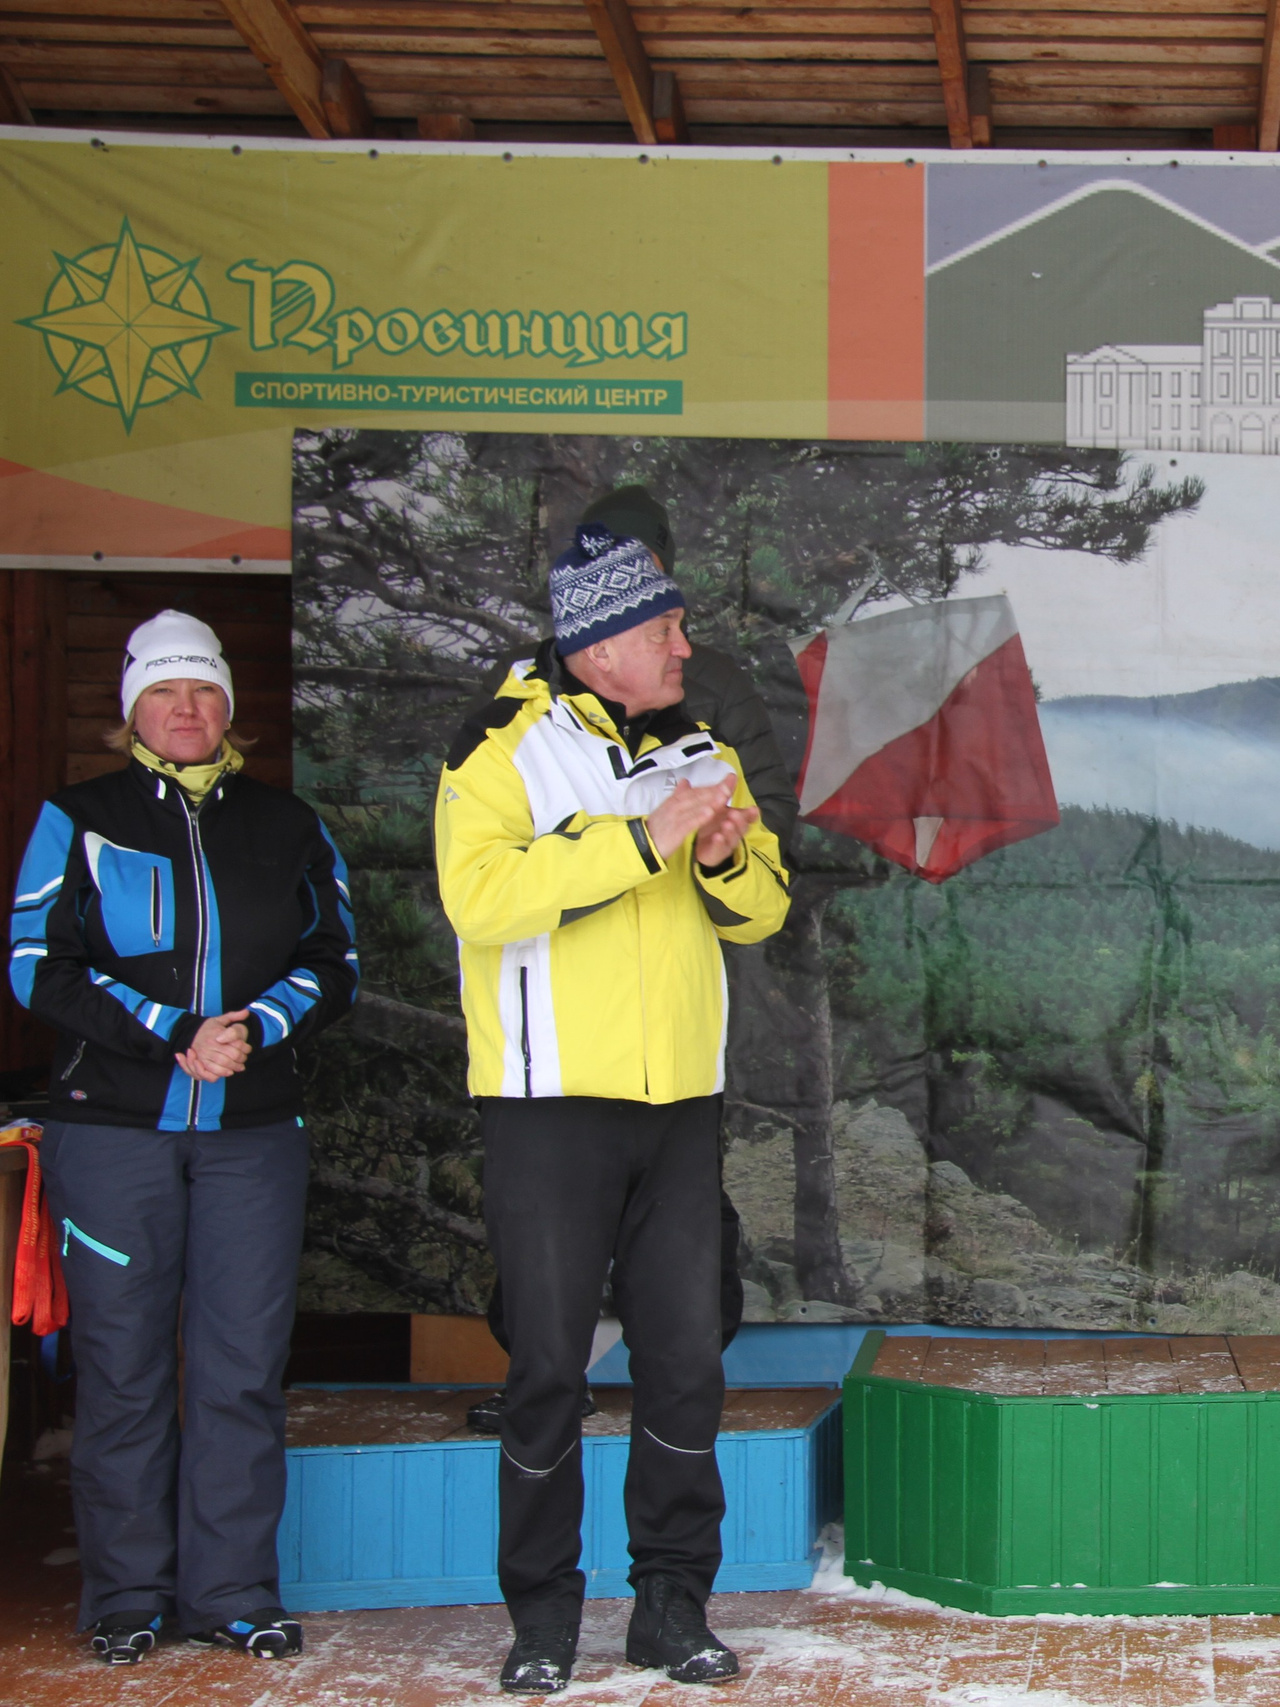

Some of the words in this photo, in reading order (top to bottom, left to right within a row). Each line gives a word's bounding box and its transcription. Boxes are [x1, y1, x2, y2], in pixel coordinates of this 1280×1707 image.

[226, 258, 688, 371] Провинция
[250, 381, 589, 406] СПОРТИВНО-ТУРИСТИЧЕСКИЙ
[594, 388, 668, 409] ЦЕНТР
[145, 655, 211, 671] FISCHER
